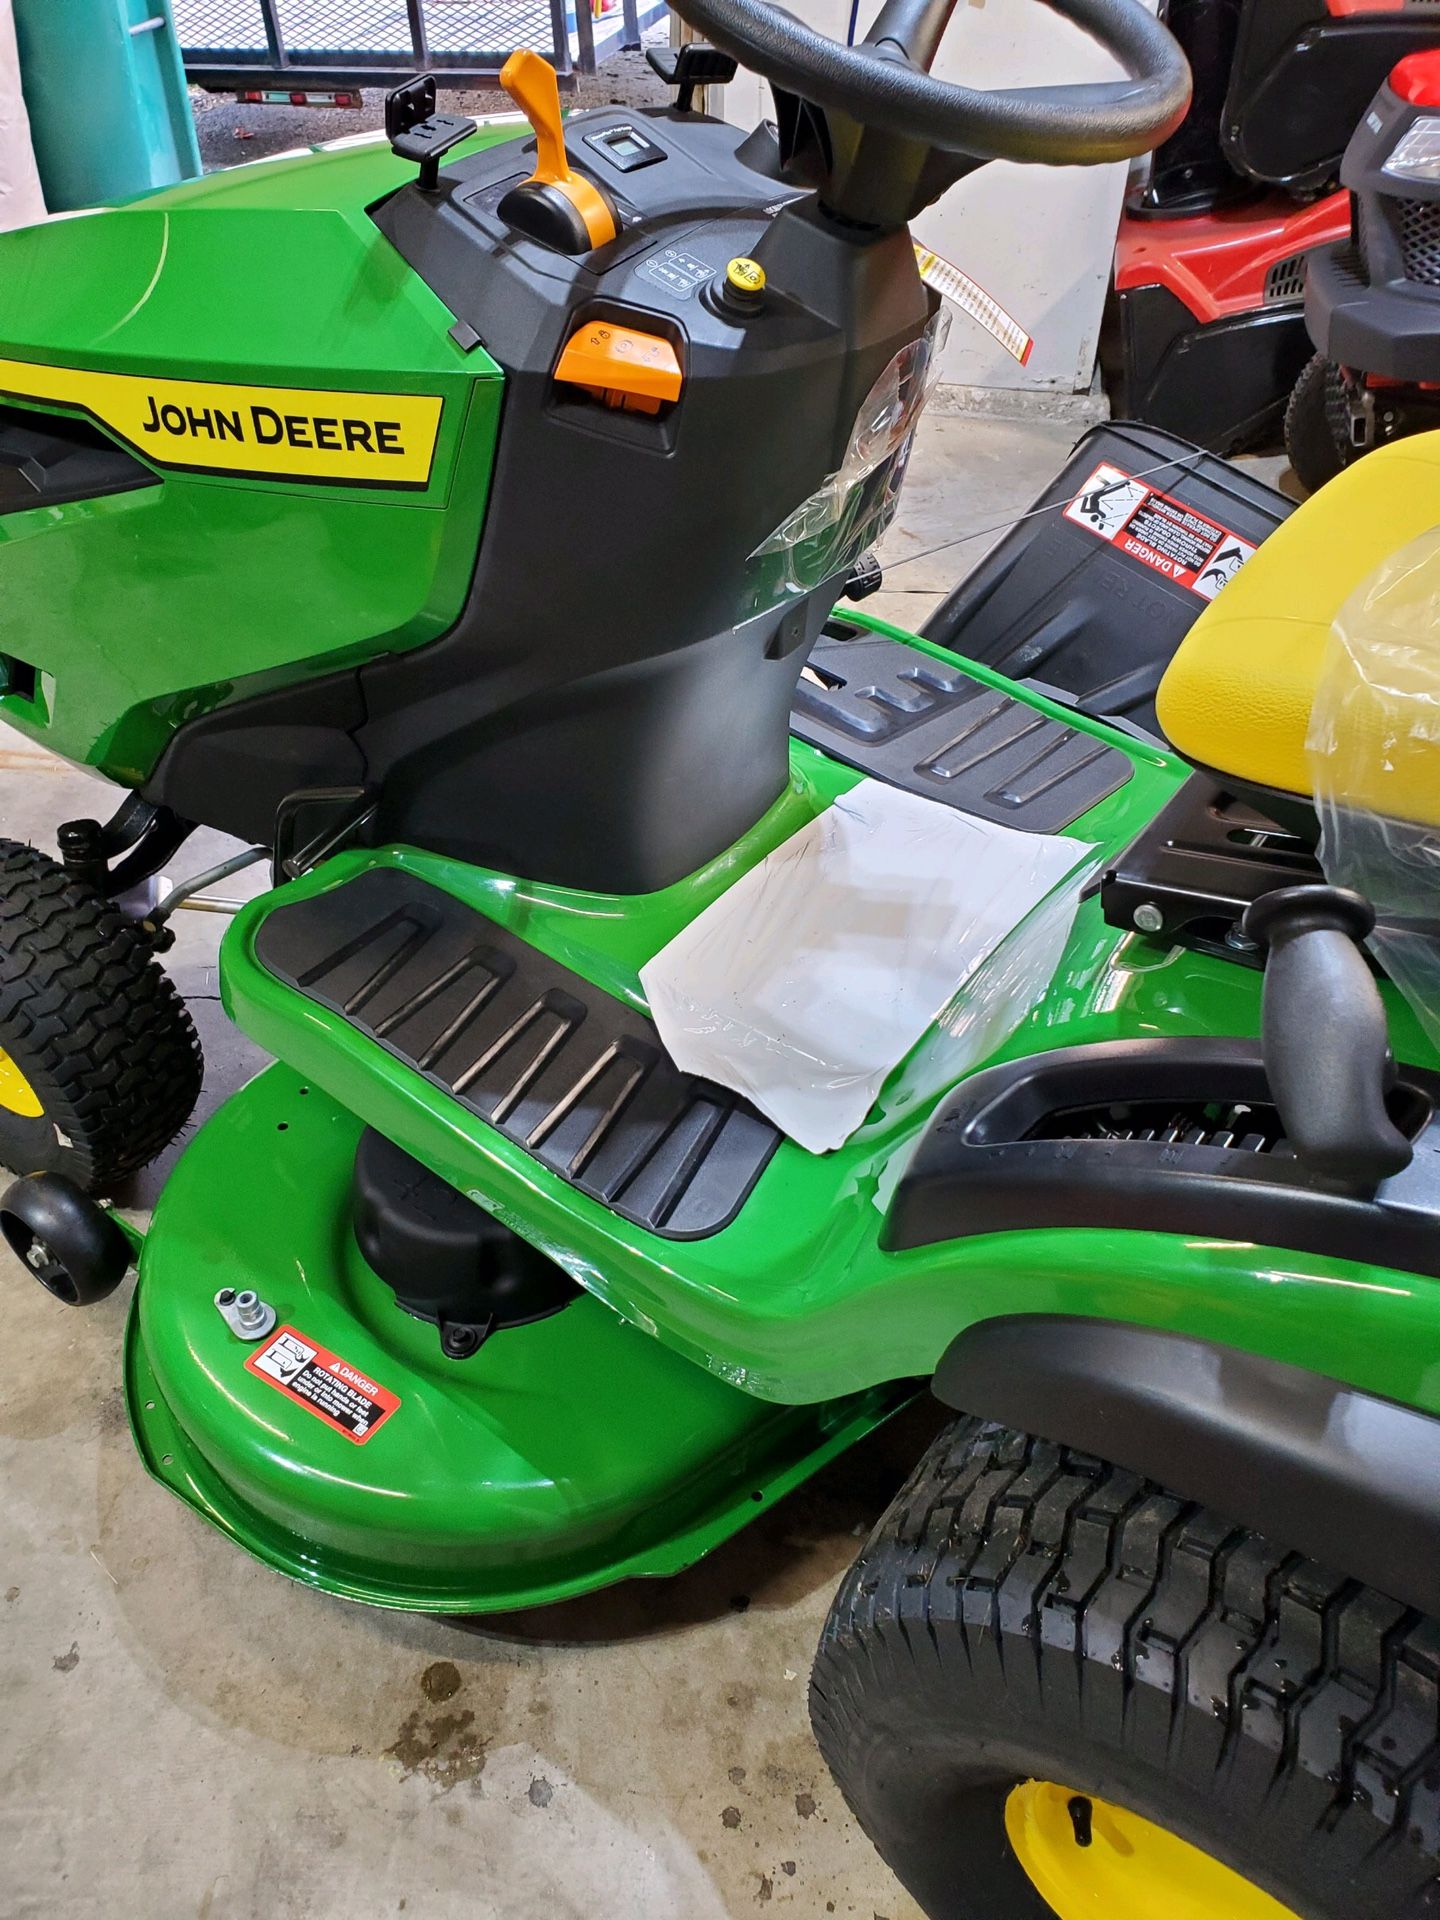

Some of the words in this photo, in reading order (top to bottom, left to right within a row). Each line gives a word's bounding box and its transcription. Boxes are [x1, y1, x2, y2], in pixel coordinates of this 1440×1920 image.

[143, 396, 245, 442] JOHN
[250, 405, 405, 455] DEERE
[1135, 532, 1157, 547] BLADE
[1142, 518, 1172, 538] OBJECTS
[1123, 537, 1173, 572] DANGER
[1155, 544, 1188, 565] ROTATING
[1170, 534, 1198, 553] THROWN
[1176, 550, 1186, 558] PUT
[1184, 555, 1194, 563] NOT
[301, 1369, 313, 1379] Do
[310, 1375, 323, 1385] not
[319, 1382, 333, 1393] put
[330, 1388, 351, 1404] hands
[347, 1401, 357, 1409] or
[355, 1405, 369, 1417] feet
[312, 1366, 349, 1393] ROTATING
[345, 1388, 373, 1408] BLADE
[339, 1367, 379, 1396] DANGER
[290, 1380, 313, 1397] engine
[310, 1393, 319, 1401] is
[315, 1397, 340, 1417] running
[296, 1375, 315, 1389] under
[312, 1386, 322, 1394] or
[319, 1390, 334, 1402] into
[331, 1398, 353, 1415] mower
[350, 1412, 369, 1426] when
